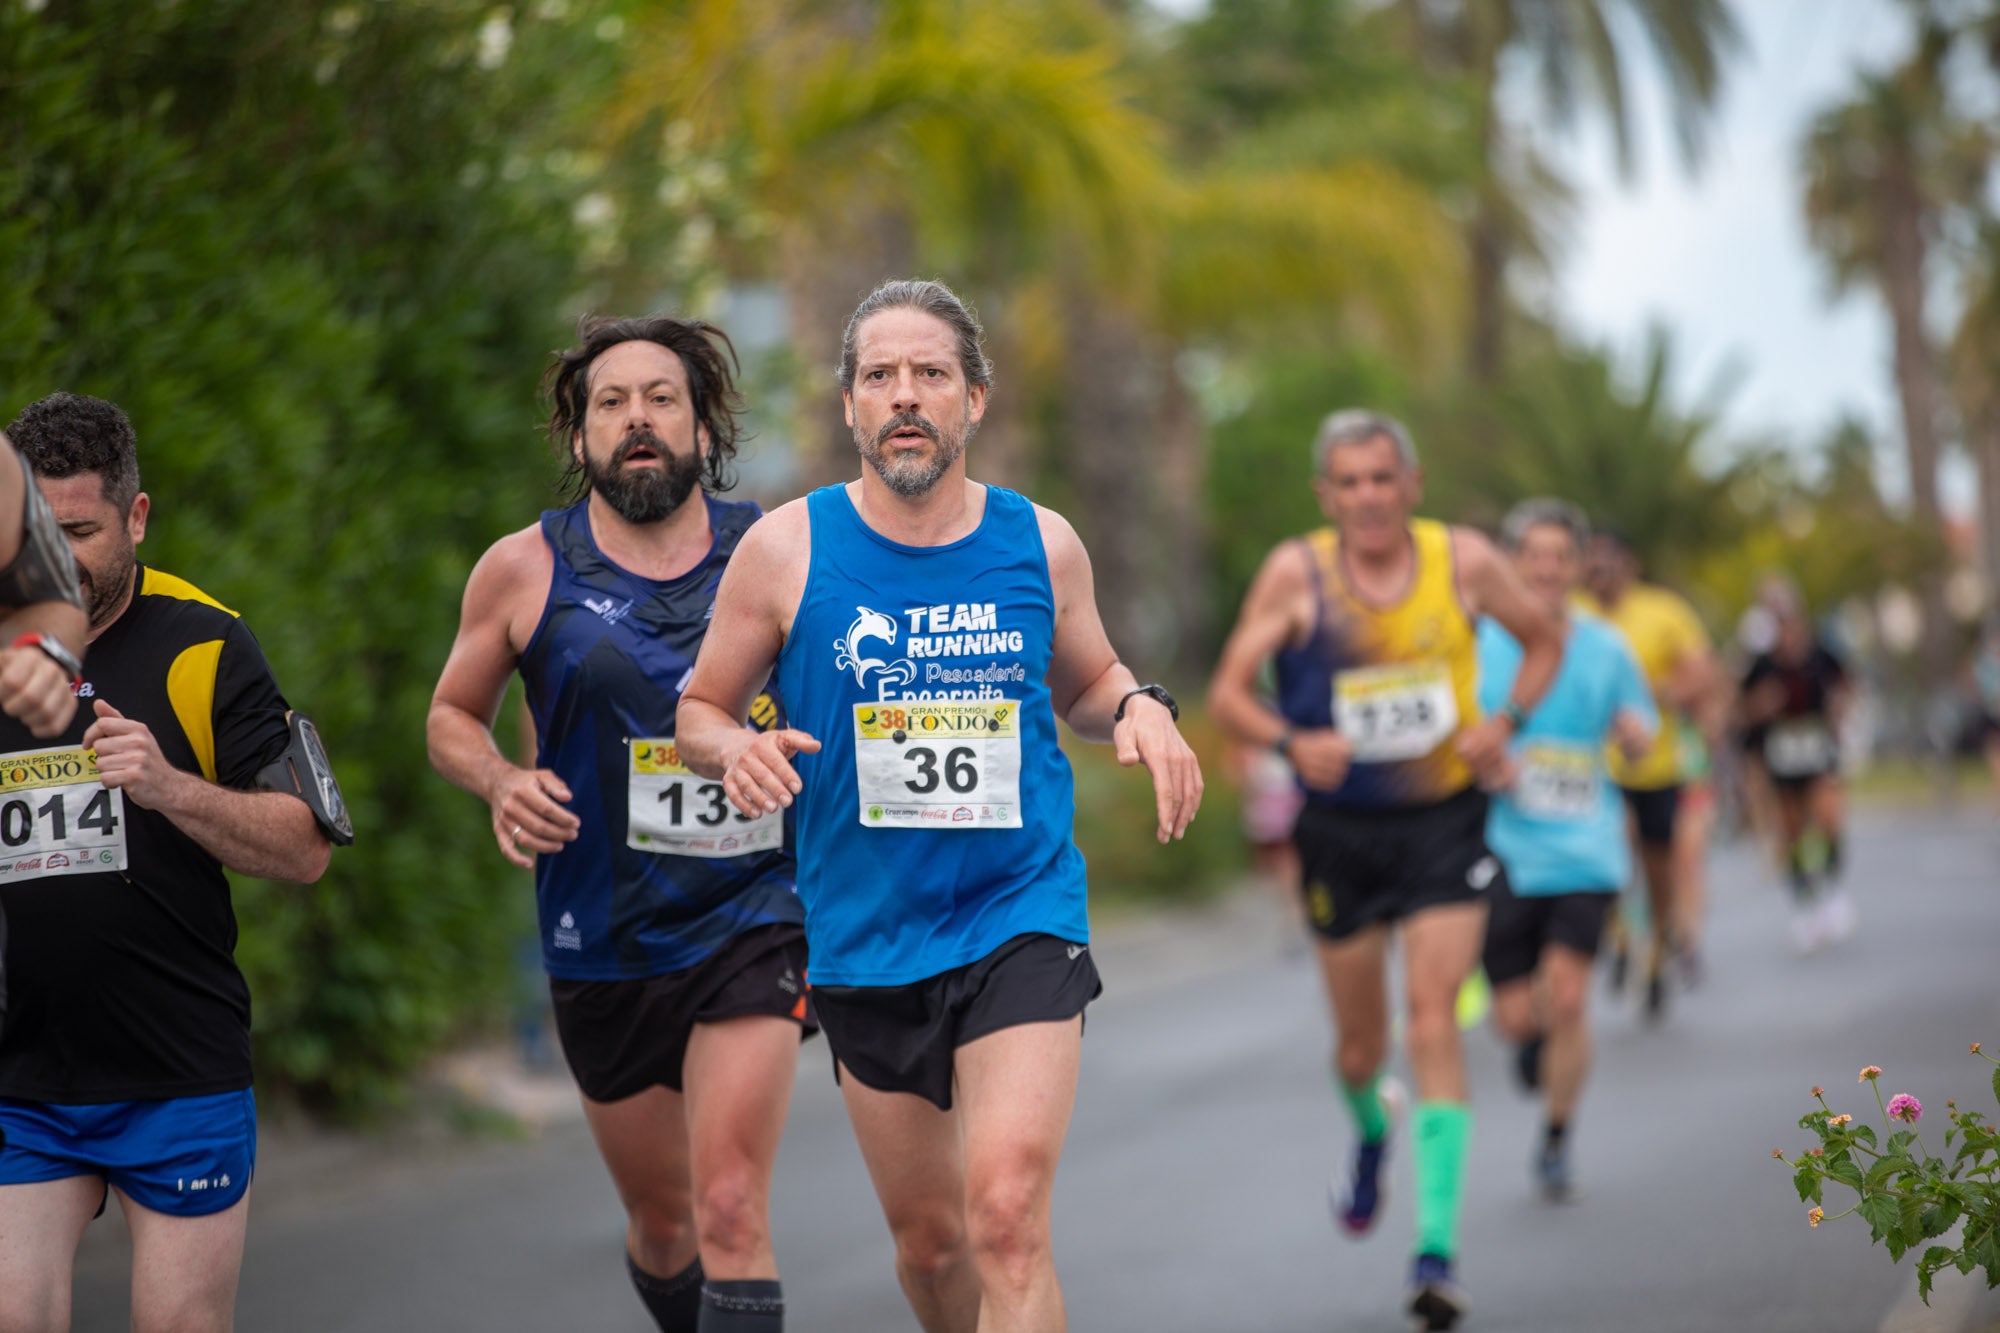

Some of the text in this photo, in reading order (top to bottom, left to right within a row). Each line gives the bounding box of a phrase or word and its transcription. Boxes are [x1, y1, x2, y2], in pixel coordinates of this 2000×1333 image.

[904, 603, 997, 634] TEAM
[907, 631, 1024, 658] RUNNING
[926, 662, 1025, 683] Pescadería
[880, 709, 906, 730] 38
[911, 707, 941, 715] GRAN
[944, 707, 981, 715] PREMIO
[908, 715, 987, 731] FONDO
[1, 758, 30, 769] GRAN
[33, 754, 72, 766] PREMIO
[654, 746, 680, 767] 38
[0, 761, 82, 785] FONDO
[903, 746, 979, 794] 36
[658, 782, 753, 827] 13
[1, 789, 119, 847] 014
